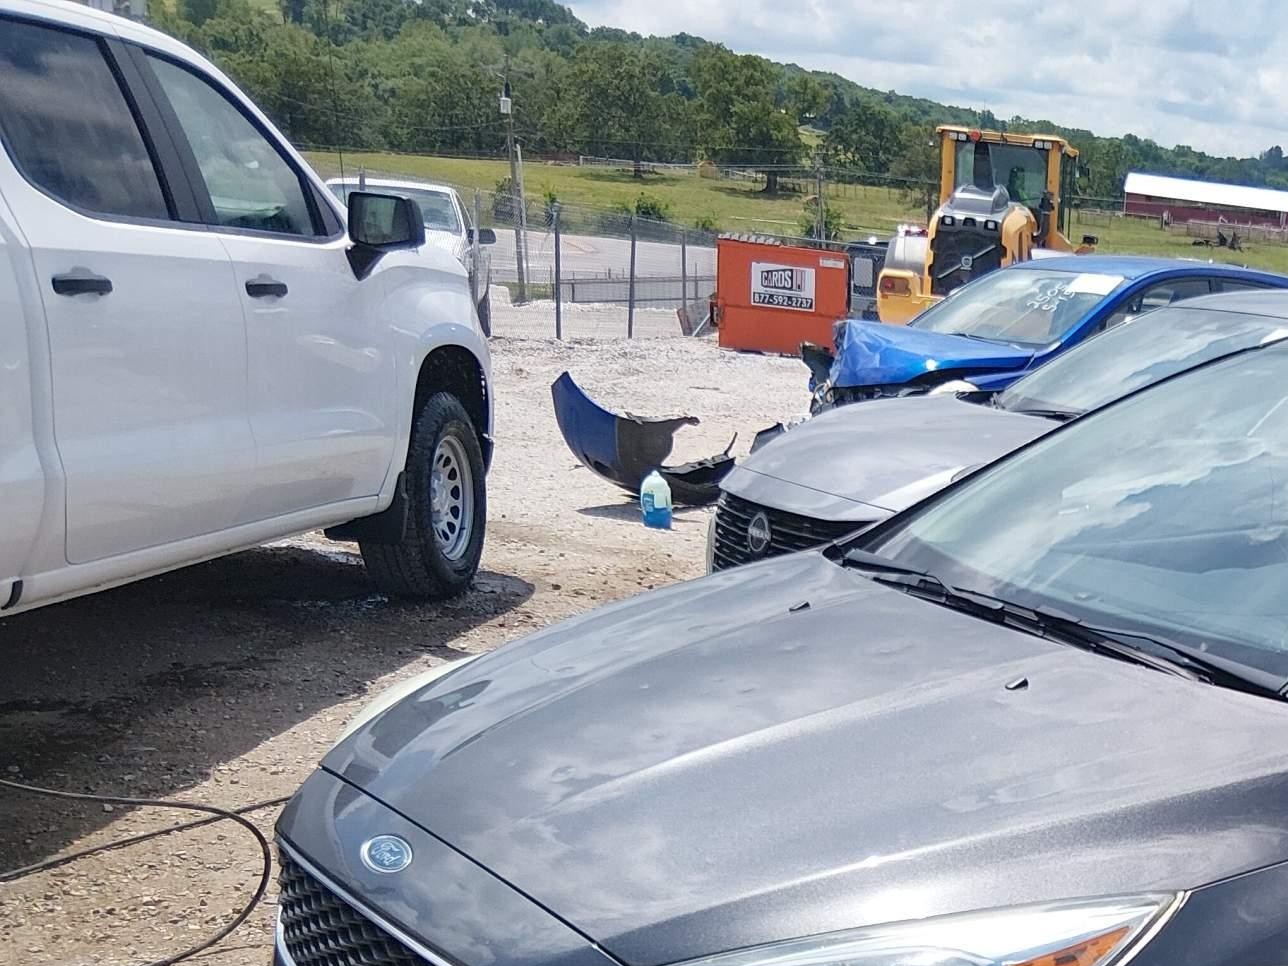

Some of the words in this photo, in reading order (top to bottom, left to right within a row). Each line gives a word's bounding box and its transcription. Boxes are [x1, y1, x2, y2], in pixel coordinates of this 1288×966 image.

[762, 270, 792, 289] CARDS
[754, 293, 812, 308] 877-592-2737
[370, 842, 402, 867] Ford
